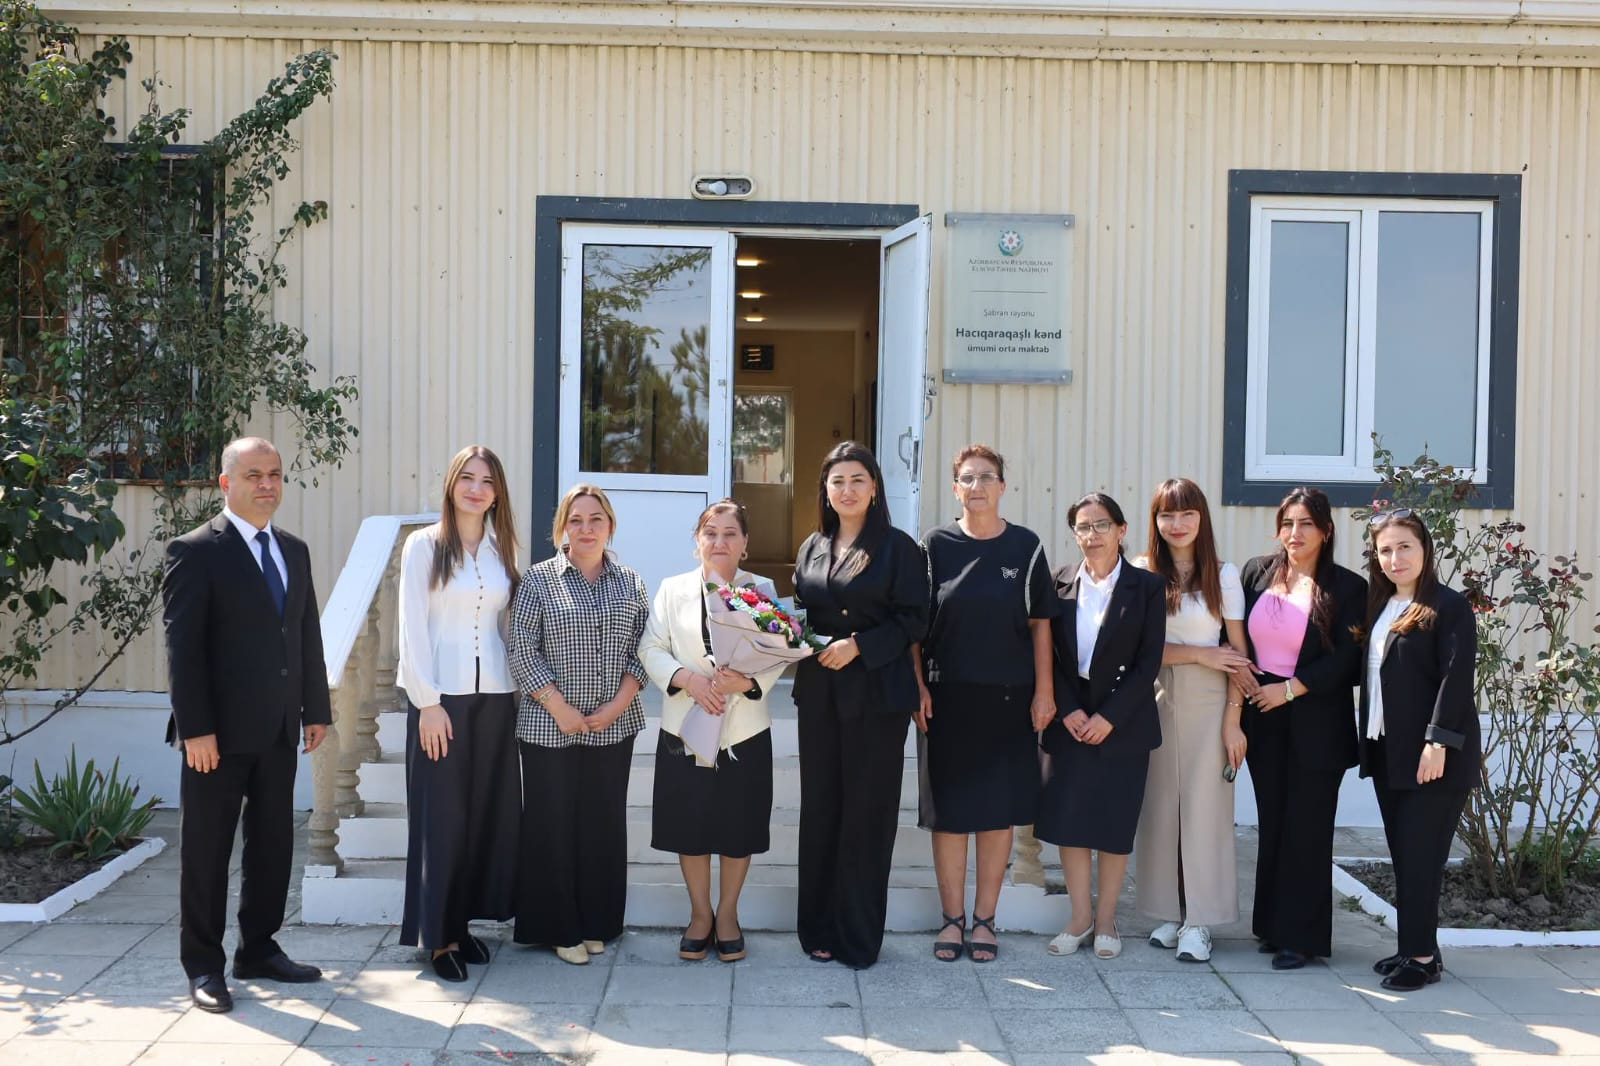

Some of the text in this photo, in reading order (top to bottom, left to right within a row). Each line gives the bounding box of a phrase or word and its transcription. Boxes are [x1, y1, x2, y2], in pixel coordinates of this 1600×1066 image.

[1010, 309, 1035, 318] rayonu
[955, 327, 1062, 341] Hacıqaraqaşlı kənd
[967, 343, 997, 352] ümumi
[998, 345, 1016, 353] orta
